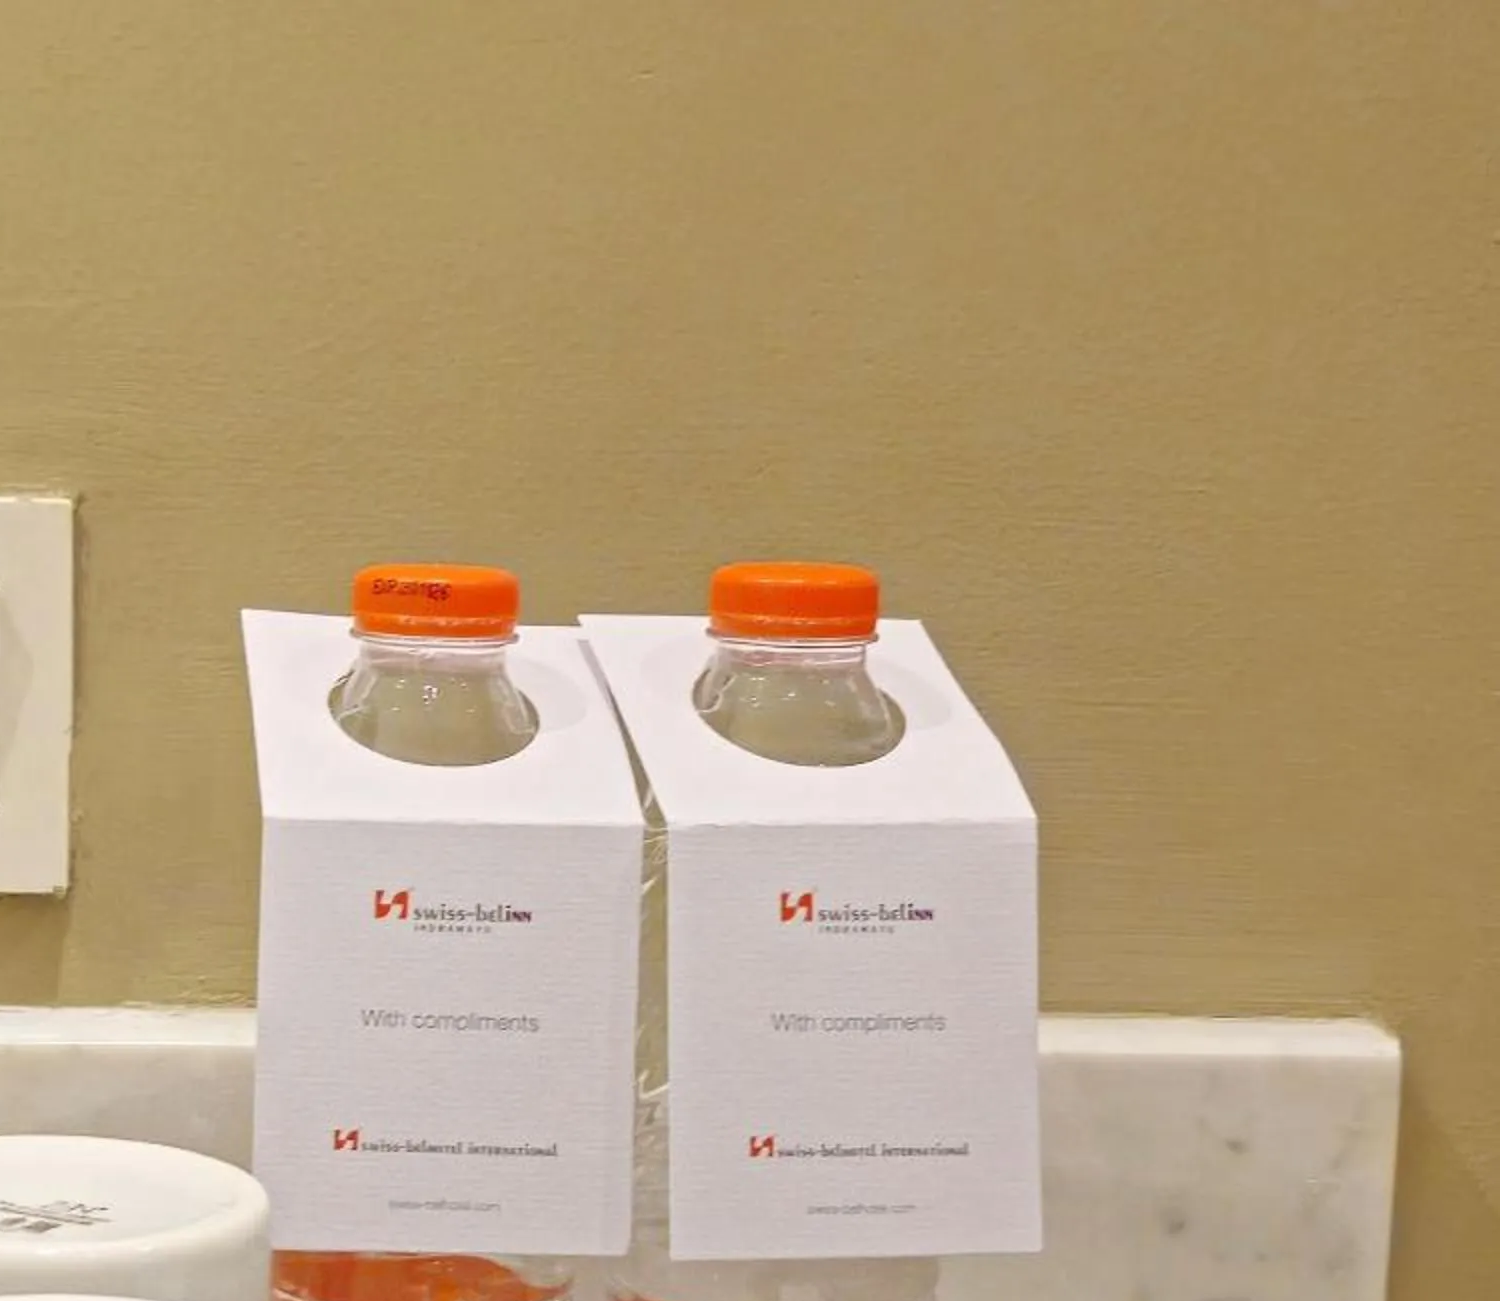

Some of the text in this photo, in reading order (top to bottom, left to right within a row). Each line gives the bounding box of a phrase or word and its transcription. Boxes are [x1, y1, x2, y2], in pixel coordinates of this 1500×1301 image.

[361, 1009, 540, 1033] With compliments
[771, 1012, 946, 1034] With compliments
